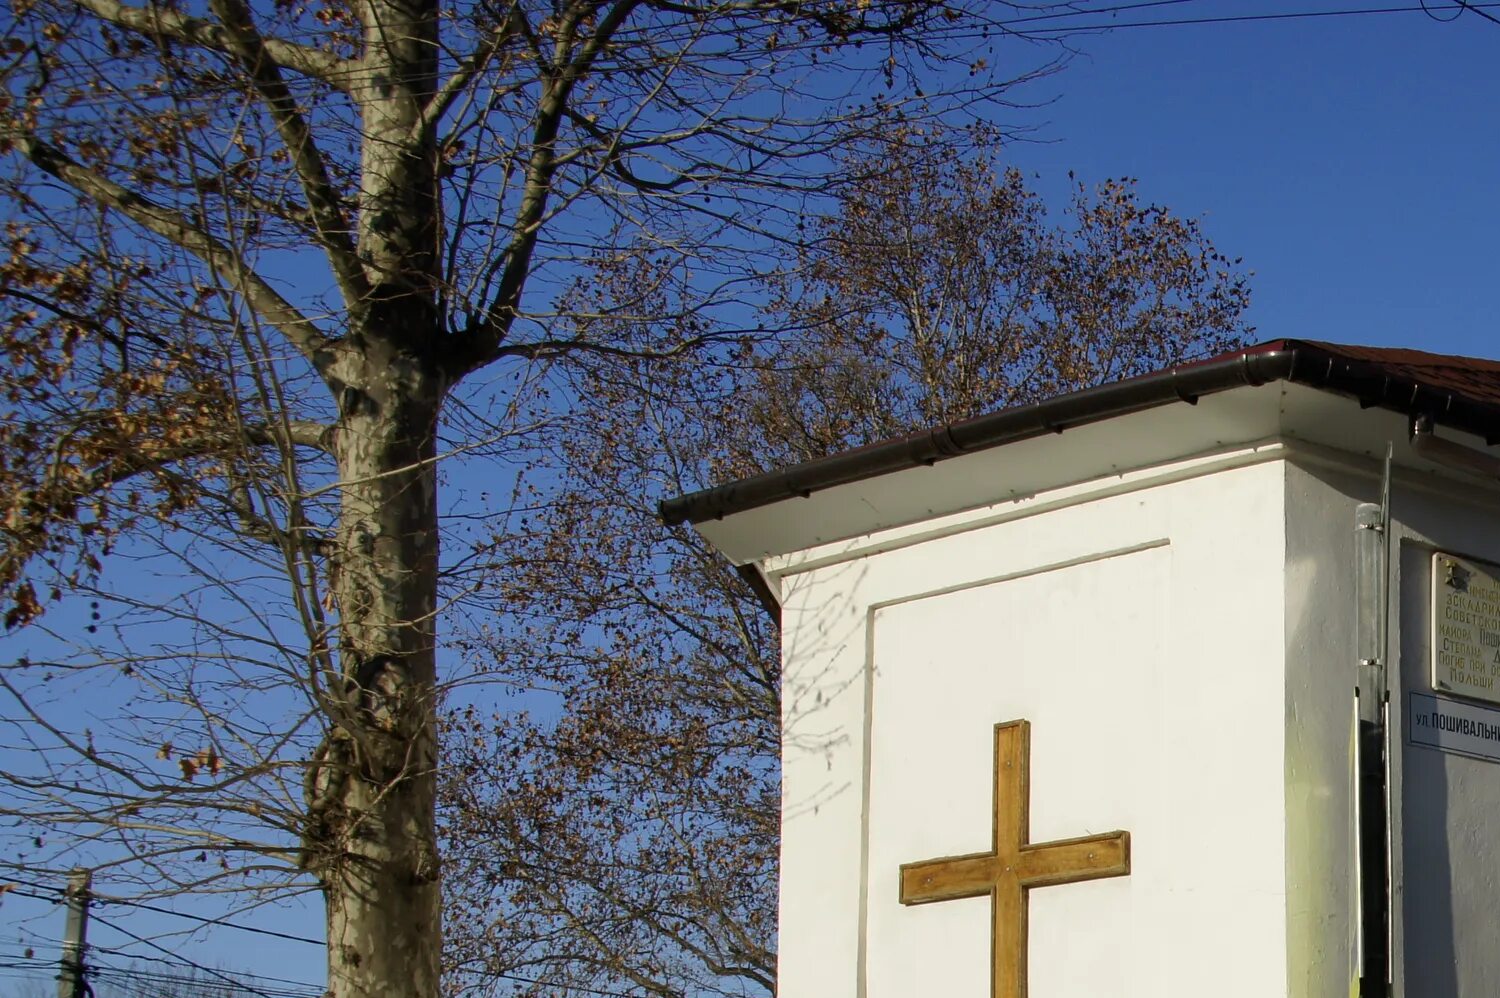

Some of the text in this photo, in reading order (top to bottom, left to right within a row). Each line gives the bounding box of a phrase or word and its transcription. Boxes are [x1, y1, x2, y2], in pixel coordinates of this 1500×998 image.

[1439, 650, 1465, 670] ПОГИБ
[1470, 659, 1486, 674] ПРИ
[1450, 668, 1494, 690] ПОЛЬШИ
